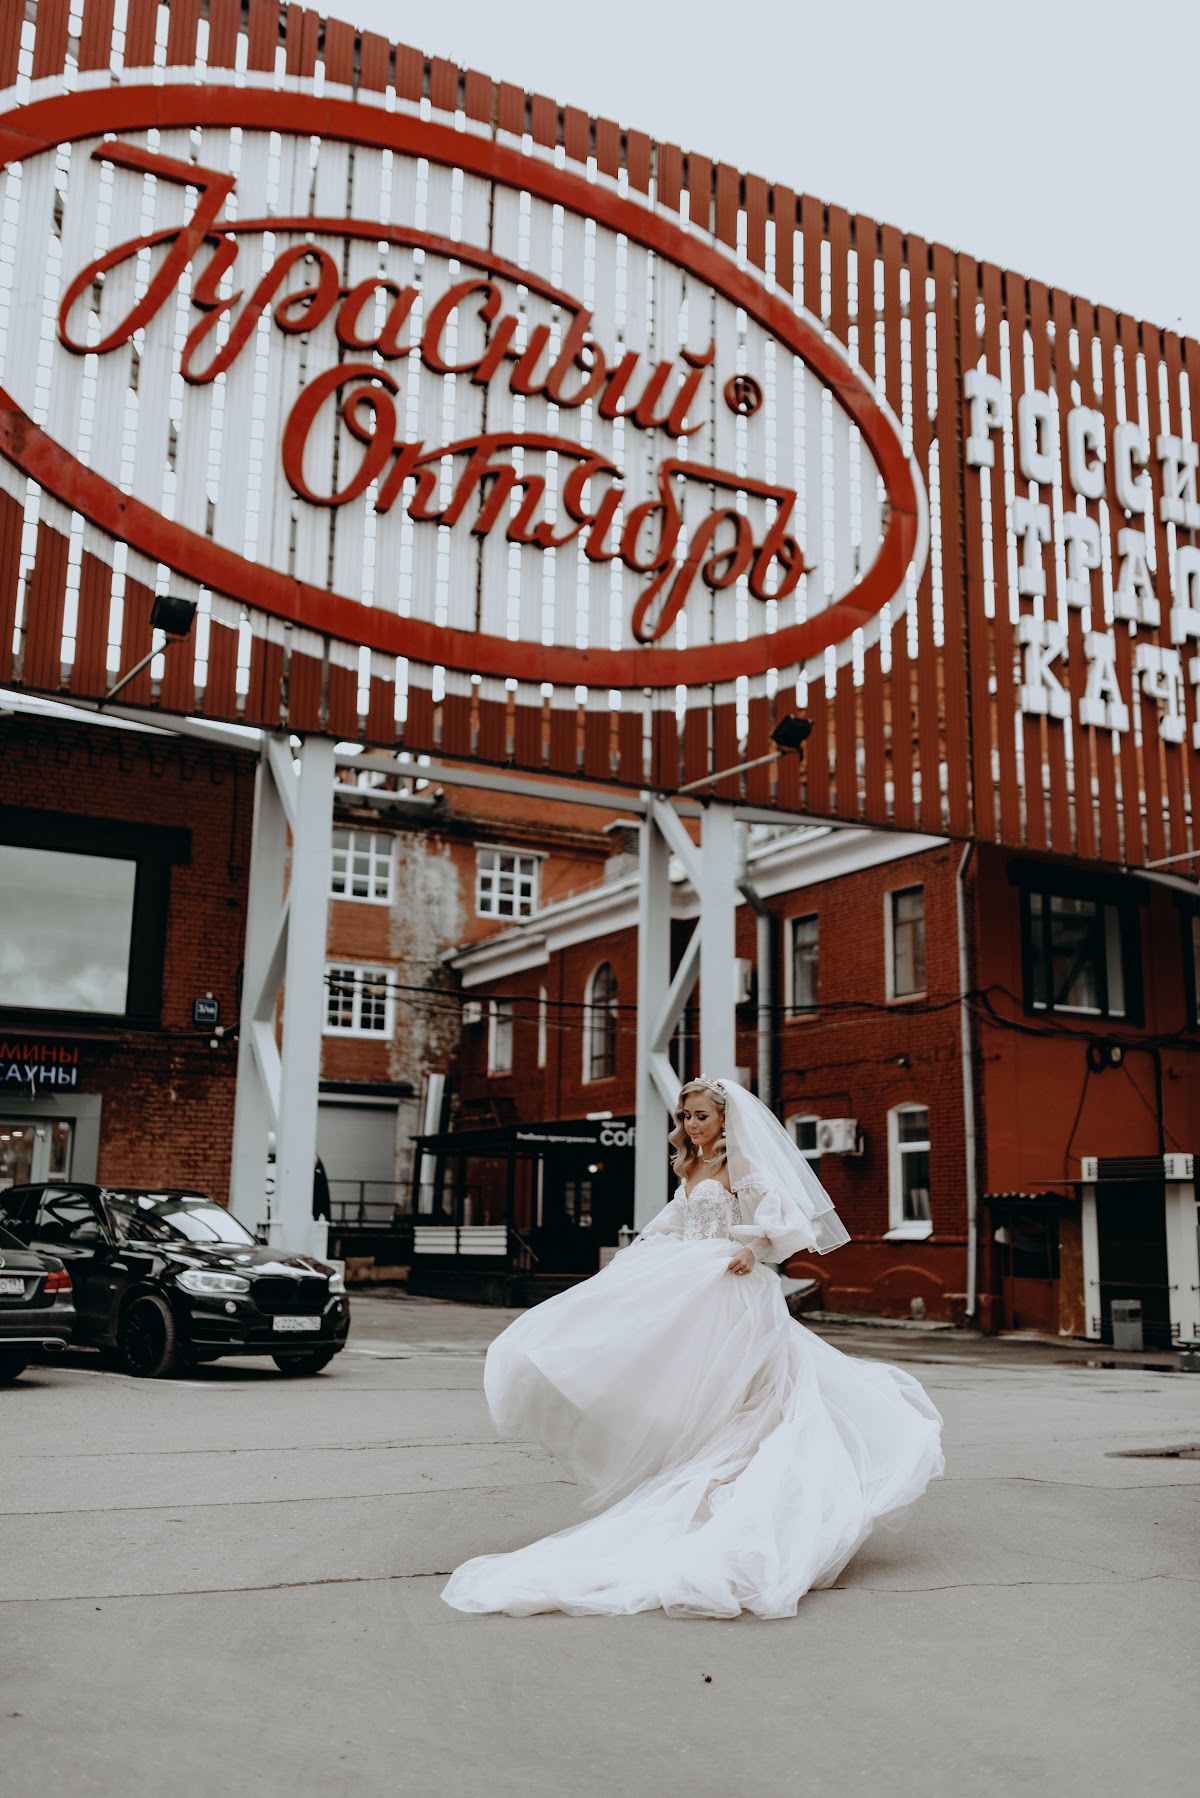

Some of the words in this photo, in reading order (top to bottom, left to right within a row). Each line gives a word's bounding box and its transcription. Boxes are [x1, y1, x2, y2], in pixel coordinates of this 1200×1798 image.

[282, 362, 817, 642] Октябрь
[1017, 613, 1200, 750] КАЧ
[600, 1127, 637, 1147] cof
